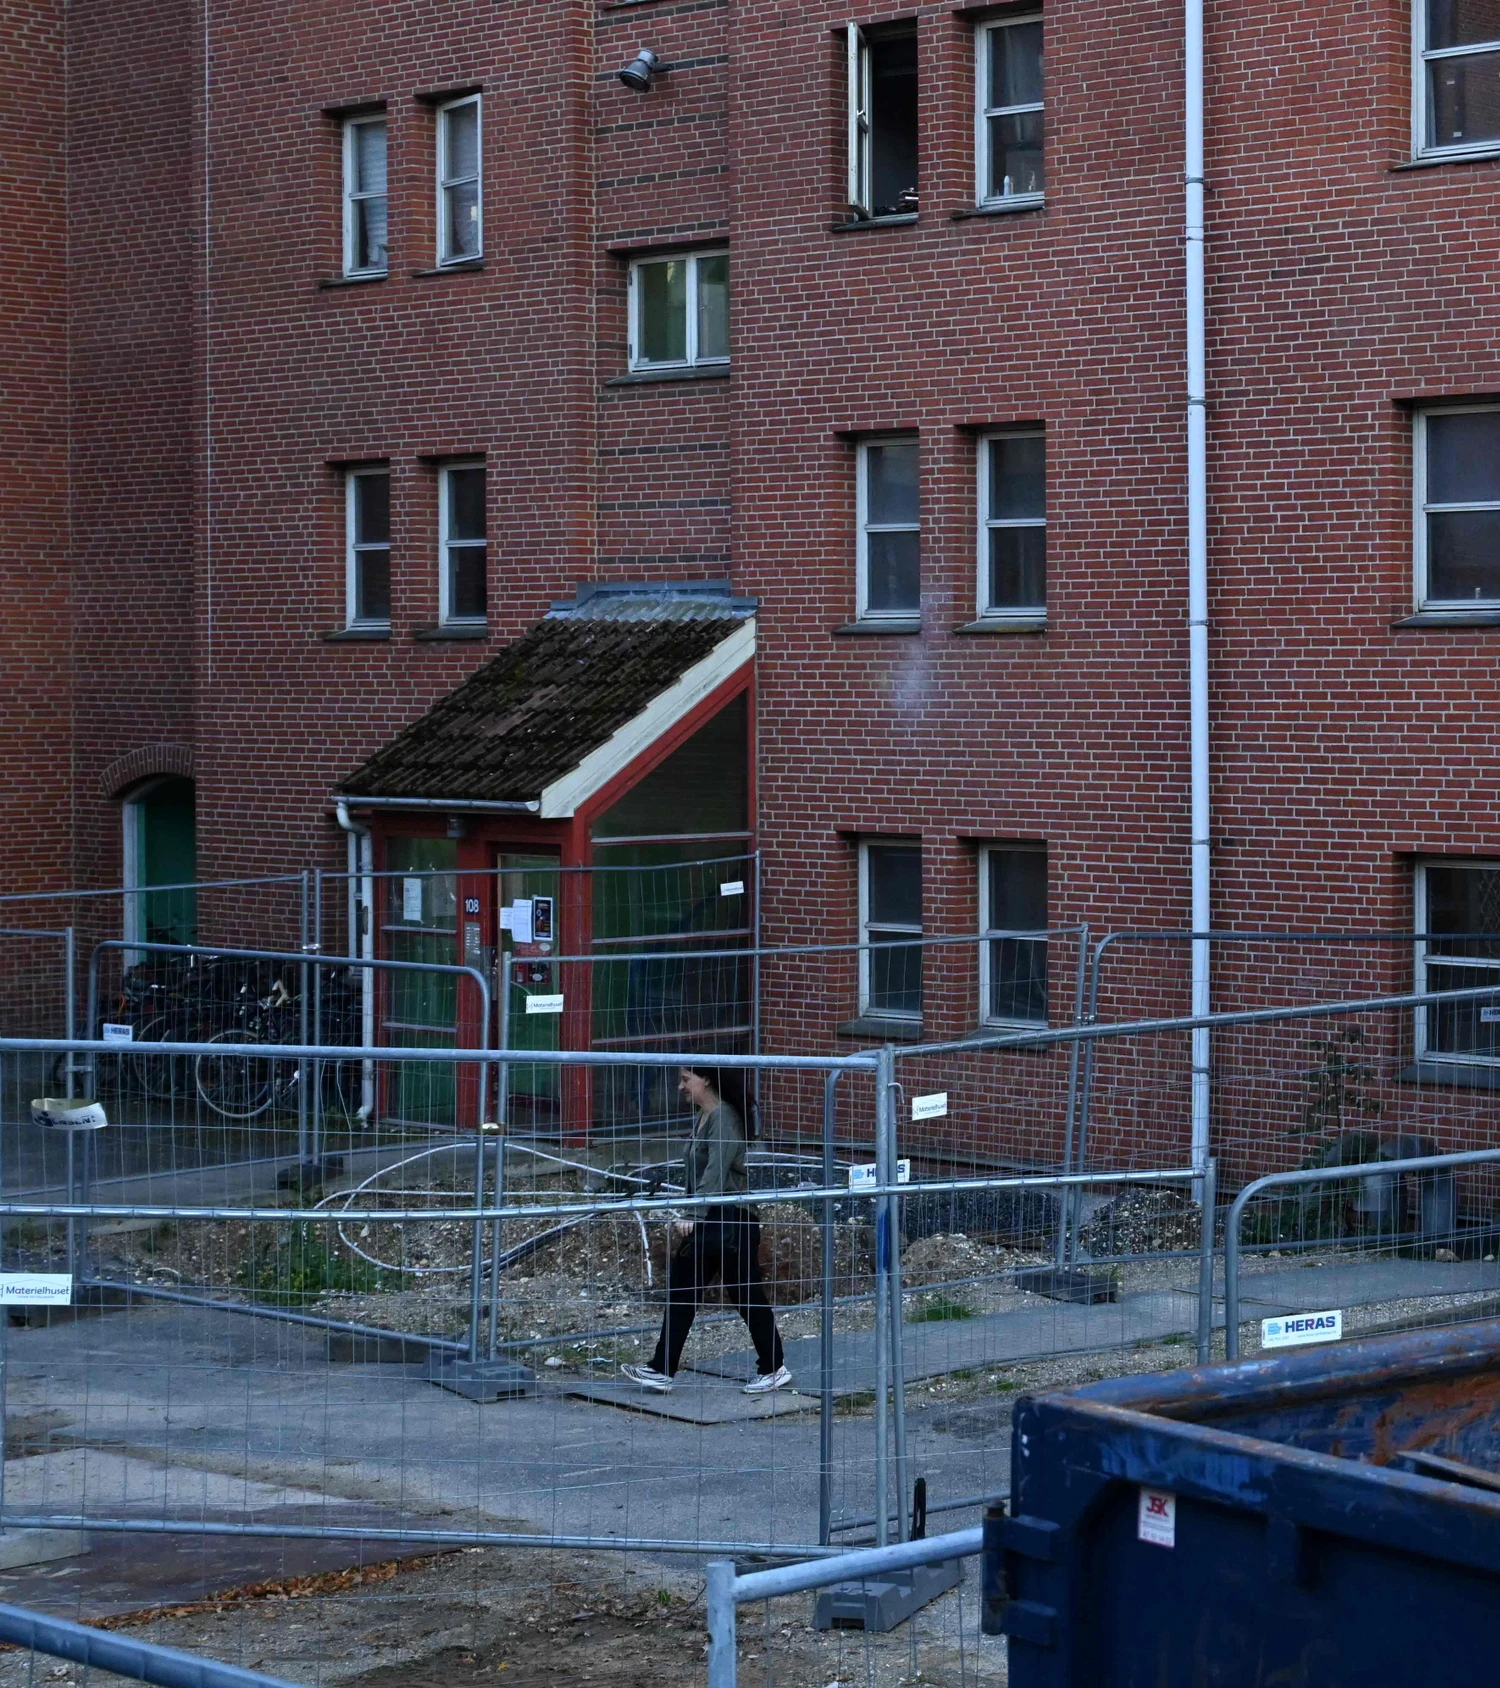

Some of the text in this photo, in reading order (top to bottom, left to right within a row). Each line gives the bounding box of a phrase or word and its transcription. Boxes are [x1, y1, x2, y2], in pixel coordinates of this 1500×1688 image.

[465, 899, 480, 913] 108
[6, 1286, 70, 1295] Materielhuset
[1285, 1316, 1336, 1333] HERAS
